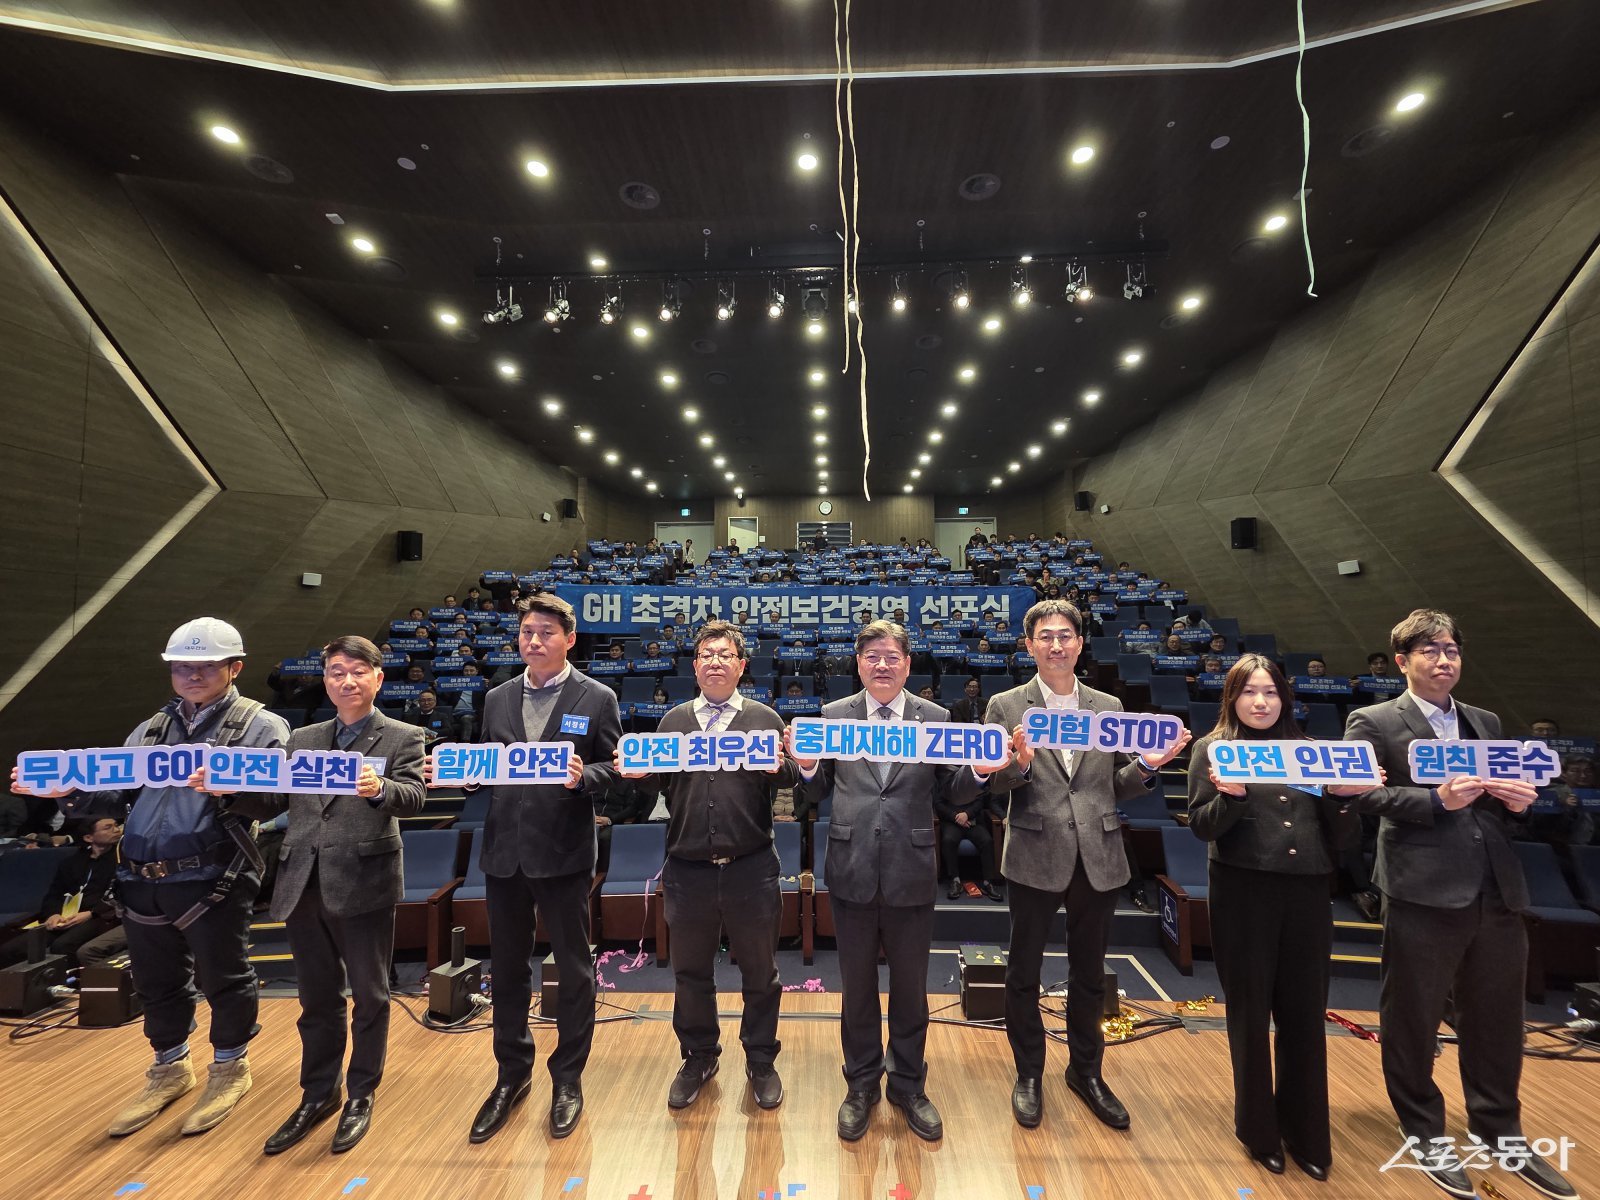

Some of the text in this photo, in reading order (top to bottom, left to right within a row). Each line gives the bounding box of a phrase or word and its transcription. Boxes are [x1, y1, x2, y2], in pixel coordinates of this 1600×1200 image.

[582, 593, 1010, 625] GH 초격차 안전보건경영 선포식
[794, 721, 1003, 761] 중대재해 ZERO
[1027, 712, 1180, 751] 위험 STOP
[437, 746, 569, 780] 함께 안전
[622, 734, 775, 768] 안전 최우선
[1214, 744, 1376, 779] 안전 인권
[1414, 744, 1554, 780] 원칙 준수
[23, 752, 136, 789] 무사고
[210, 752, 279, 786] 안전
[290, 755, 358, 790] 실천
